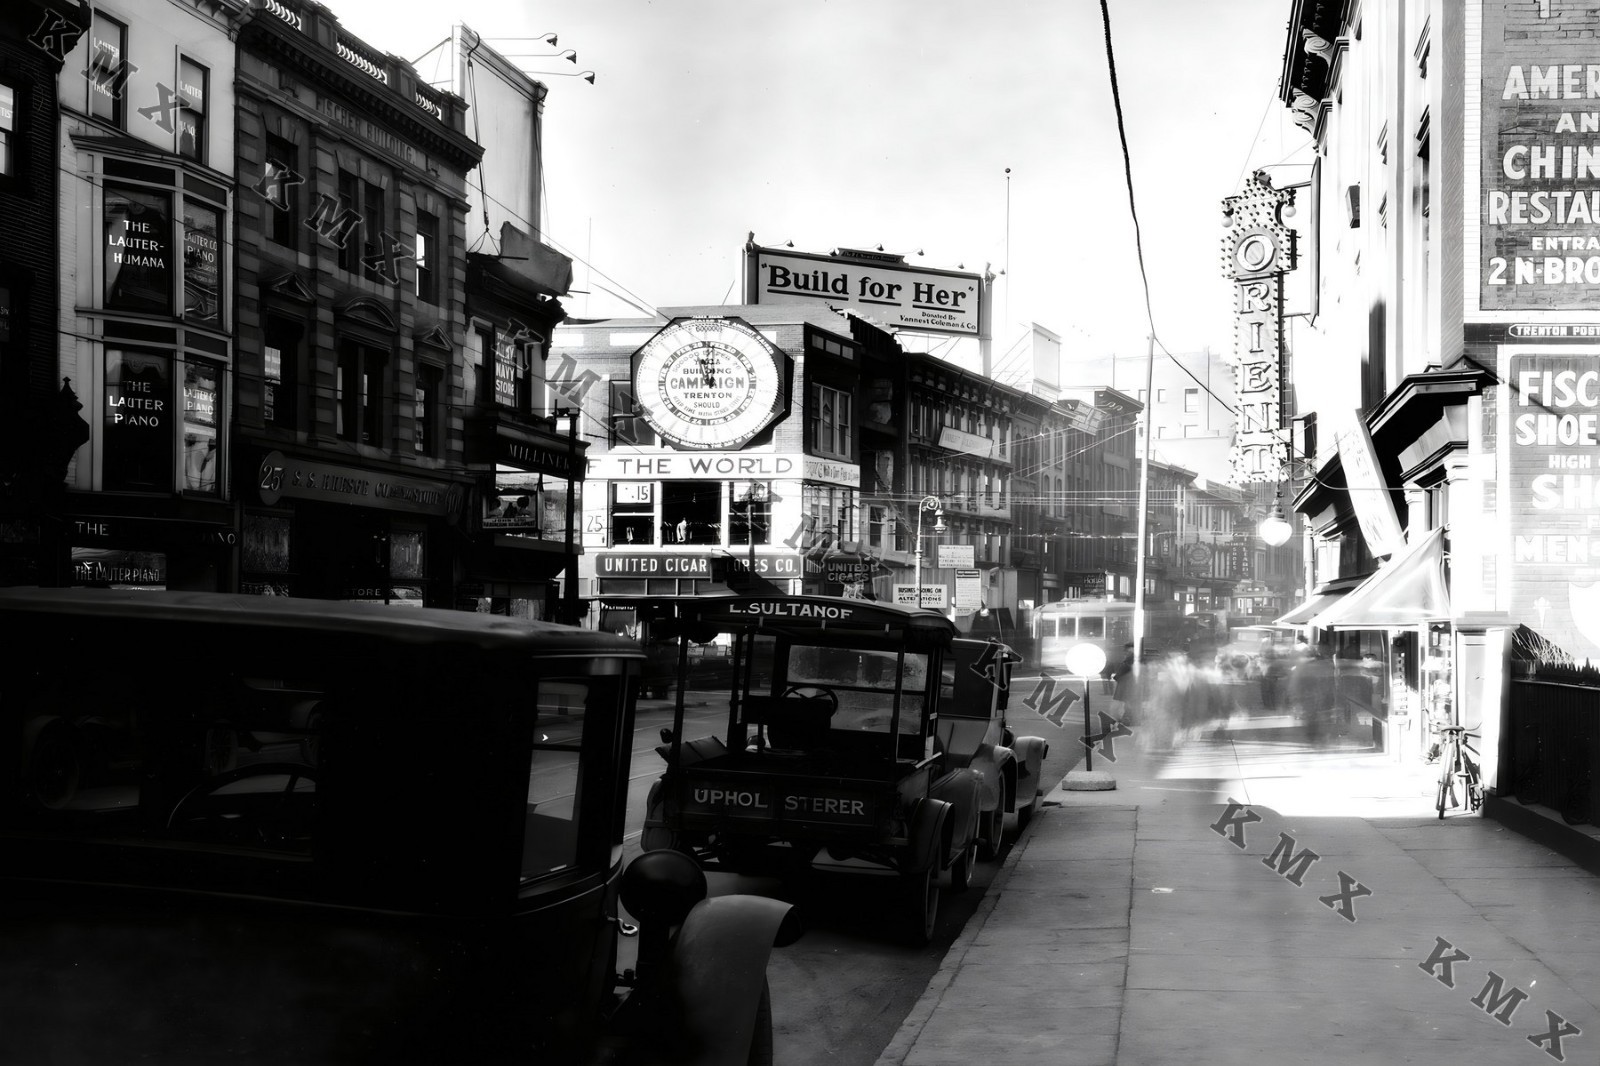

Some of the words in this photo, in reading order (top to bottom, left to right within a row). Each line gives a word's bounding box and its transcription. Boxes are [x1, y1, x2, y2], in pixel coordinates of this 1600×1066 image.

[123, 219, 151, 234] THE
[113, 252, 165, 269] HUMANA
[187, 245, 214, 263] PIANO
[1488, 257, 1507, 285] 2
[858, 276, 902, 300] for
[921, 311, 947, 320] Donated
[1516, 326, 1567, 336] TRENTON
[1234, 233, 1277, 475] ORIENT
[123, 380, 151, 393] THE
[495, 379, 515, 396] STORE
[109, 395, 164, 411] LAUTER
[187, 401, 213, 415] PIANO
[693, 401, 721, 409] SHOULD
[114, 412, 159, 428] PIANO
[617, 457, 672, 475] THE
[689, 456, 793, 475] WORLD
[1549, 454, 1591, 469] HIGH
[1531, 474, 1600, 510] SH
[75, 521, 110, 536] THE
[604, 557, 658, 573] UNITED
[665, 557, 708, 573] CIGAR
[774, 558, 798, 573] CO.
[827, 562, 870, 573] UNITED
[827, 572, 870, 582] CIGARS
